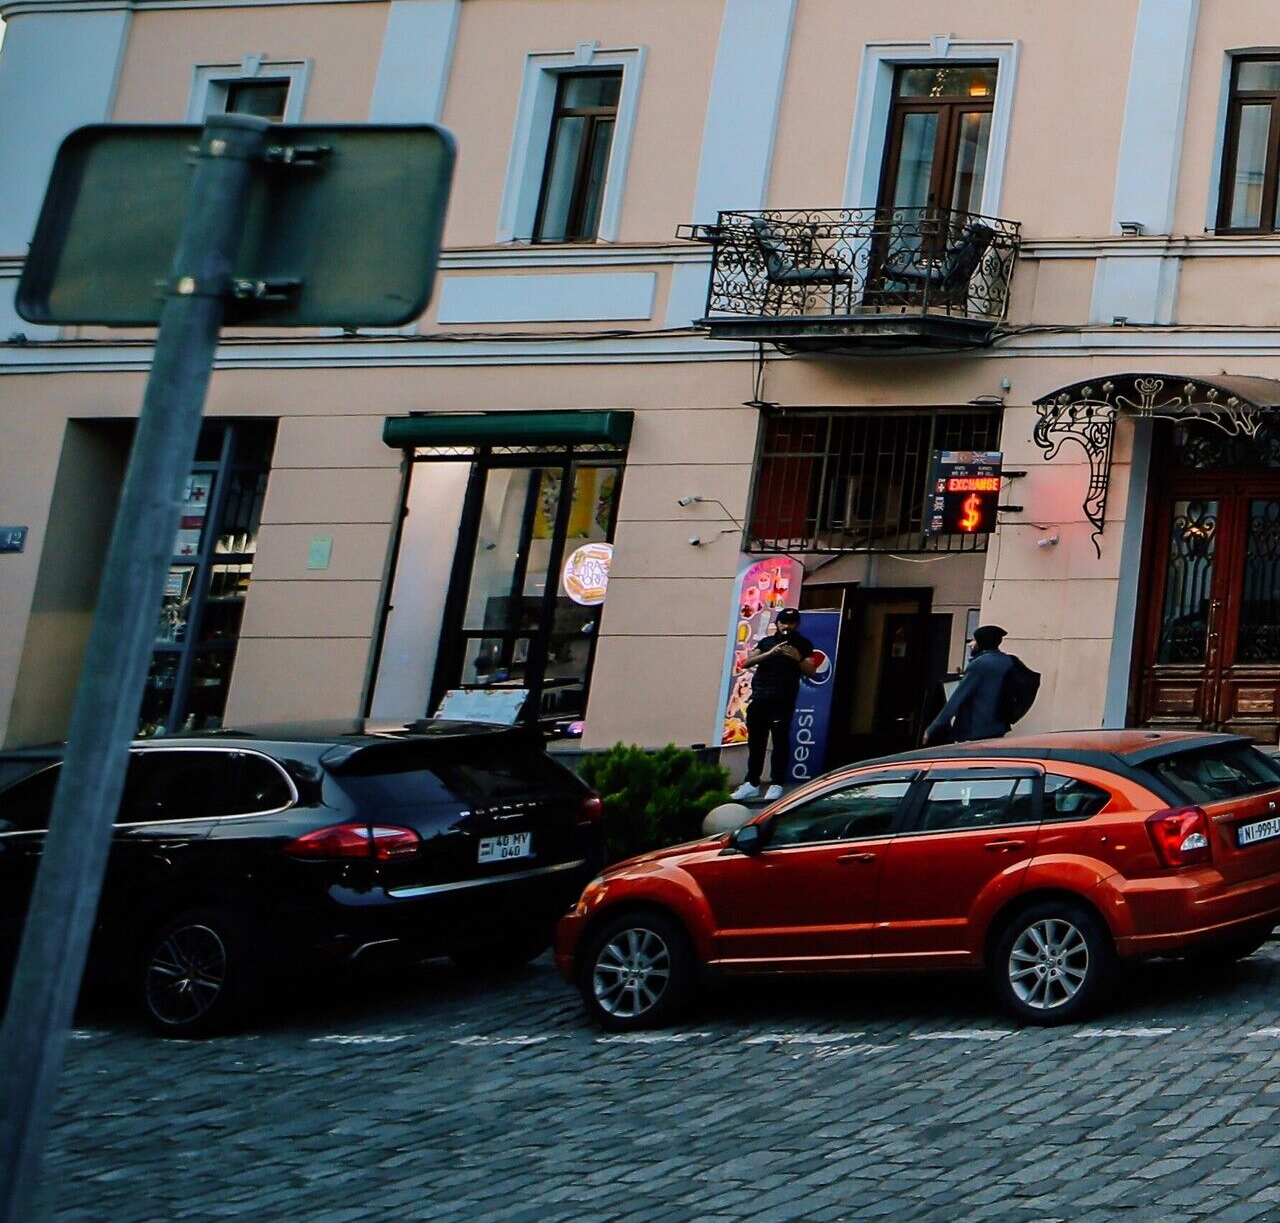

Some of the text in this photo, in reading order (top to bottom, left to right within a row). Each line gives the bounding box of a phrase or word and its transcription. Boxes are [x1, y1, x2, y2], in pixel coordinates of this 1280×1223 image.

[948, 478, 1000, 491] EXCHANGE
[792, 708, 815, 780] pepsi
[513, 834, 529, 845] MY
